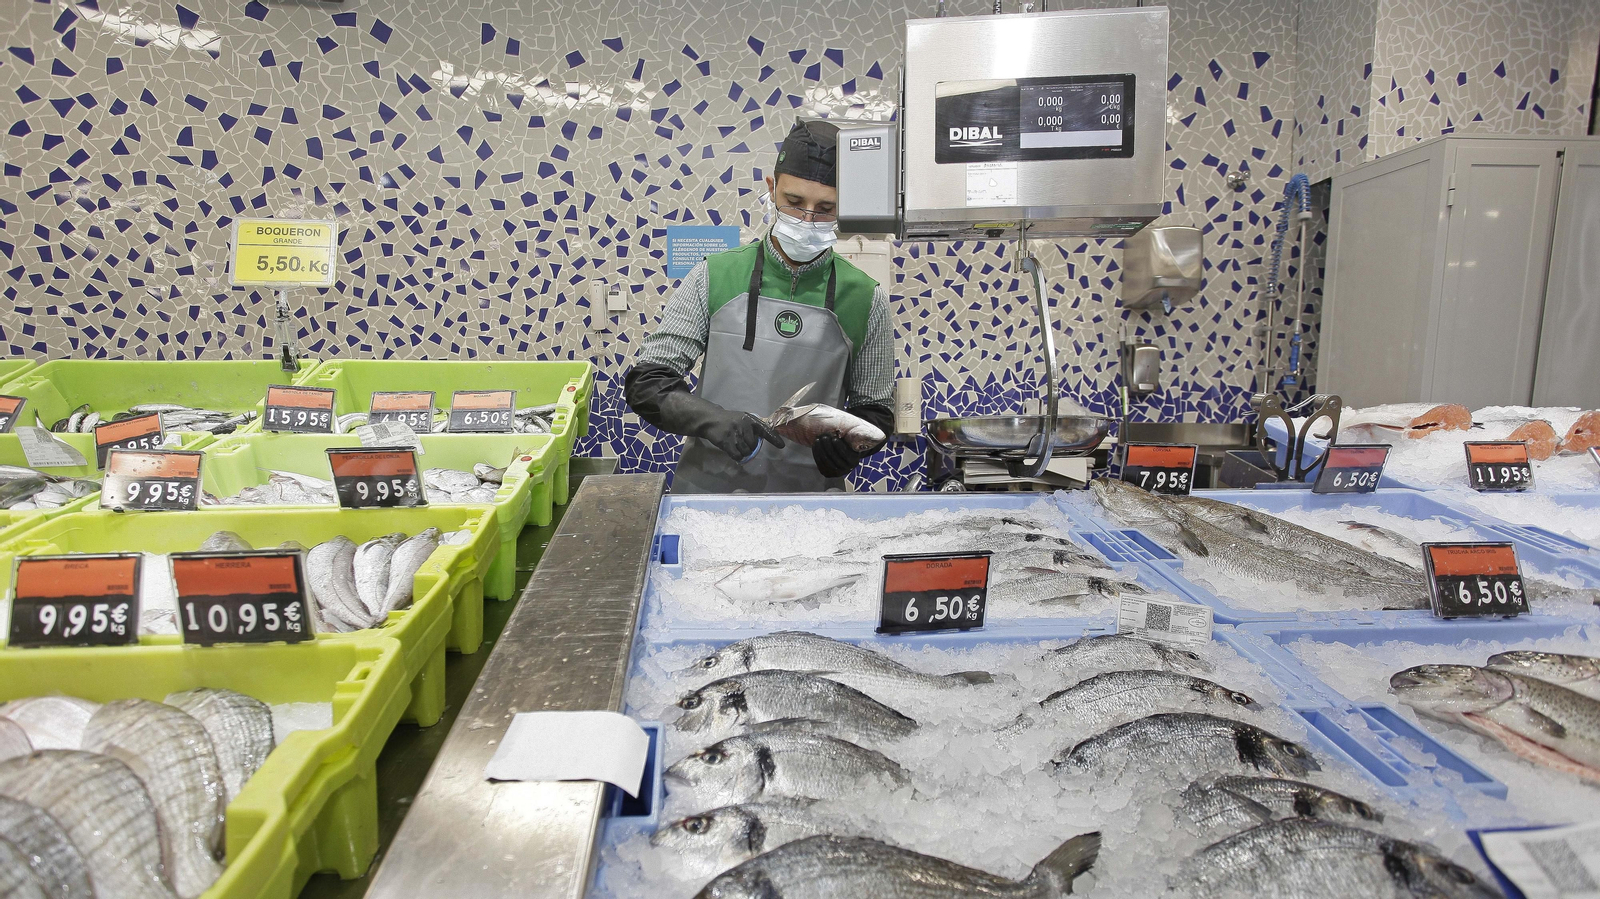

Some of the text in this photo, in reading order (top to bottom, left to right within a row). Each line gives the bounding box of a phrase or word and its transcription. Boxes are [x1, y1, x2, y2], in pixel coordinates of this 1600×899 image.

[1037, 94, 1121, 107] 0,000 0,00
[1037, 113, 1121, 127] 0,000 0,00
[949, 126, 1003, 143] DIBAL
[850, 138, 881, 148] DIBAL
[256, 226, 321, 238] BOQUERON
[273, 237, 303, 245] GRANDE
[309, 260, 329, 275] Kg
[214, 561, 252, 570] HERRERA
